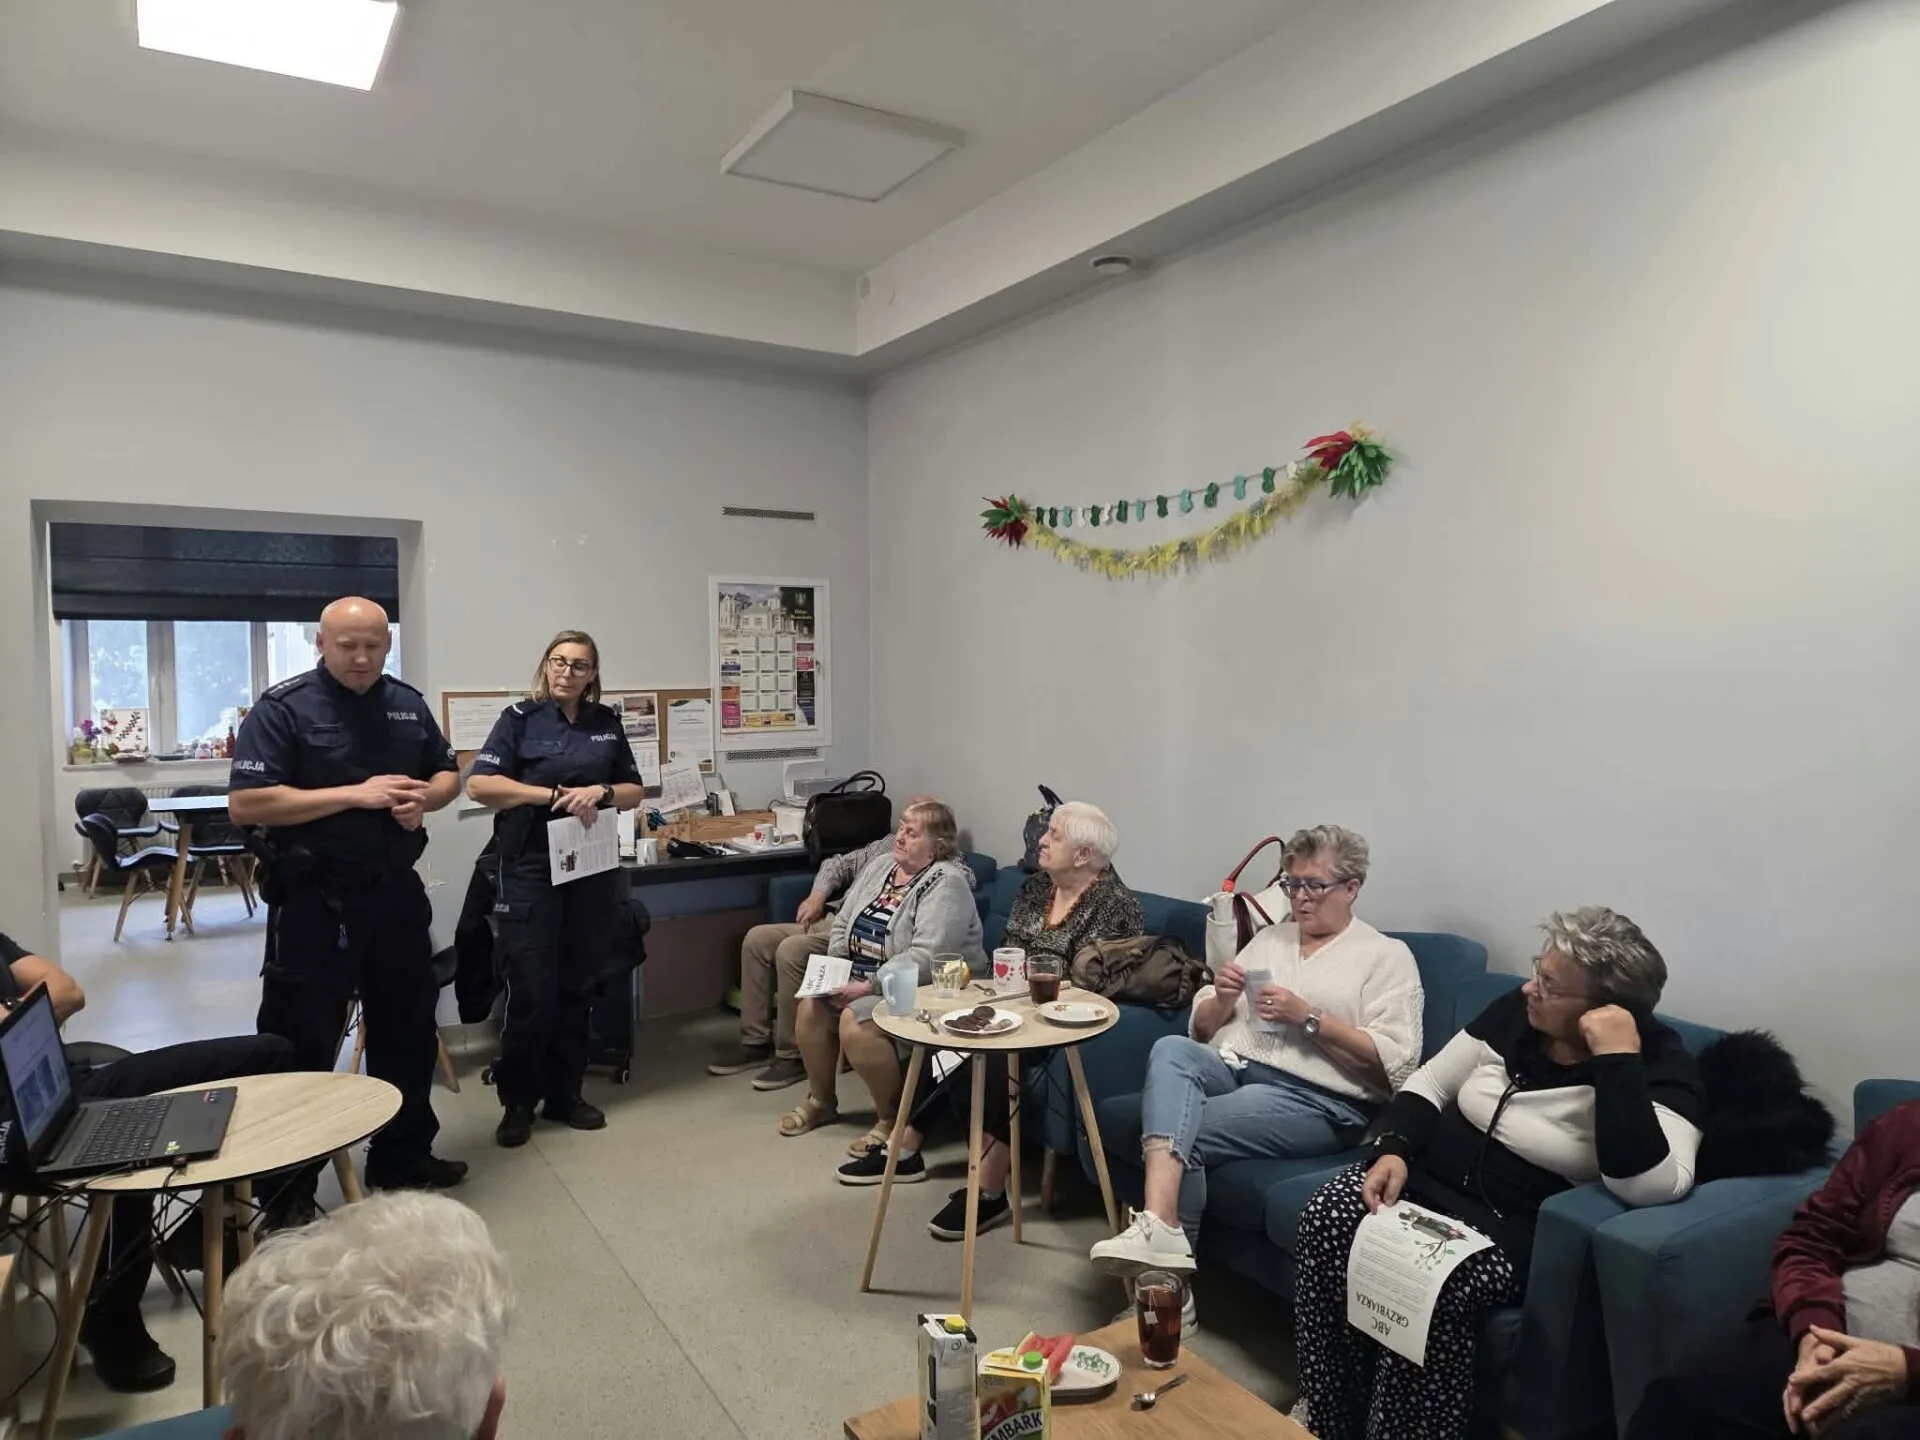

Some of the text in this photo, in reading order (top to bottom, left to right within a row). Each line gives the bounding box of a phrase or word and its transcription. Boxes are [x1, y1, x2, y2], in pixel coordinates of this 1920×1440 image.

[386, 711, 418, 721] POLICJA
[590, 733, 617, 742] POLICJA
[1356, 1290, 1409, 1328] GRZYBIARZA
[1371, 1316, 1392, 1336] ABC
